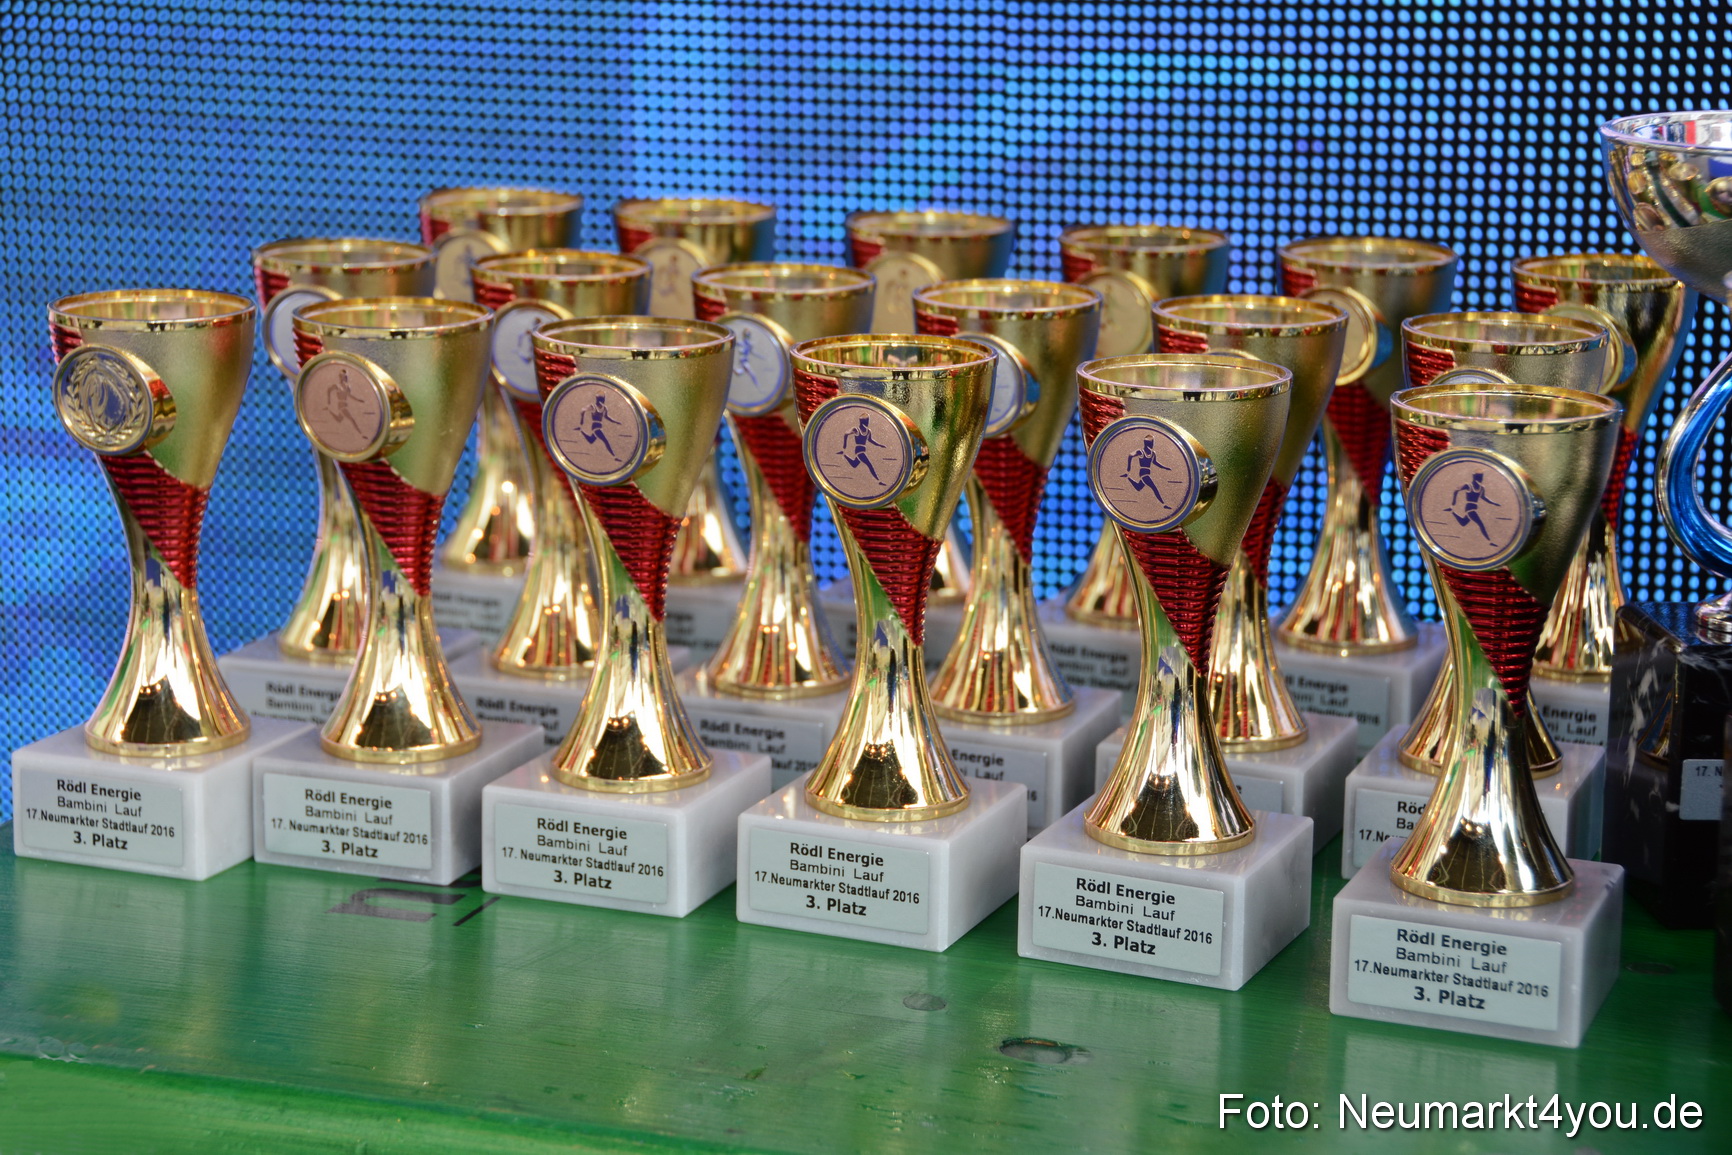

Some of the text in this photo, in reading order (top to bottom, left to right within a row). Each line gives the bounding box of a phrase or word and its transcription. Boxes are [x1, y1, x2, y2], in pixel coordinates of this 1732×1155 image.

[509, 701, 558, 717] Energie
[1542, 705, 1597, 723] Energie
[700, 719, 785, 741] Rödl Energie
[1567, 722, 1597, 737] Lauf
[951, 749, 1004, 767] Energie
[975, 768, 1004, 781] Lauf
[57, 779, 142, 802] Rödl Energie
[305, 789, 392, 810] Rödl Energie
[58, 796, 142, 817] Bambini Lauf
[305, 806, 393, 825] Bambini Lauf
[1397, 800, 1427, 815] Röd
[26, 808, 175, 837] 17.Neumarkter Stadtlauf 2016
[271, 818, 428, 845] 17. Neumarkter Stadtlauf 2016
[537, 818, 627, 840] Rödl Energie
[73, 831, 128, 850] 3. Platz
[322, 840, 378, 858] 3. Platz
[537, 835, 627, 856] Bambini Lauf
[502, 847, 664, 877] 17. Neumarkter Stadtlauf 2016
[790, 842, 884, 867] Rödl Energie
[554, 870, 612, 889] 3. Platz
[790, 859, 884, 883] Bambini Lauf
[755, 871, 920, 904] 17.Neumarkter Stadtlauf 2016
[1076, 877, 1175, 905] Rödl Energie
[806, 895, 867, 916] 3. Platz
[1076, 895, 1175, 921] Bambini Lauf
[1038, 905, 1212, 944] 17.Neumarkter Stadtlauf 2016
[1091, 932, 1156, 955] 3. Platz
[1397, 929, 1507, 956] Rödl Energie
[1396, 947, 1508, 973] Bambini Lauf
[1354, 960, 1549, 997] 17.Neumarkter Stadtlauf 2016
[1413, 986, 1485, 1010] 3. Platz
